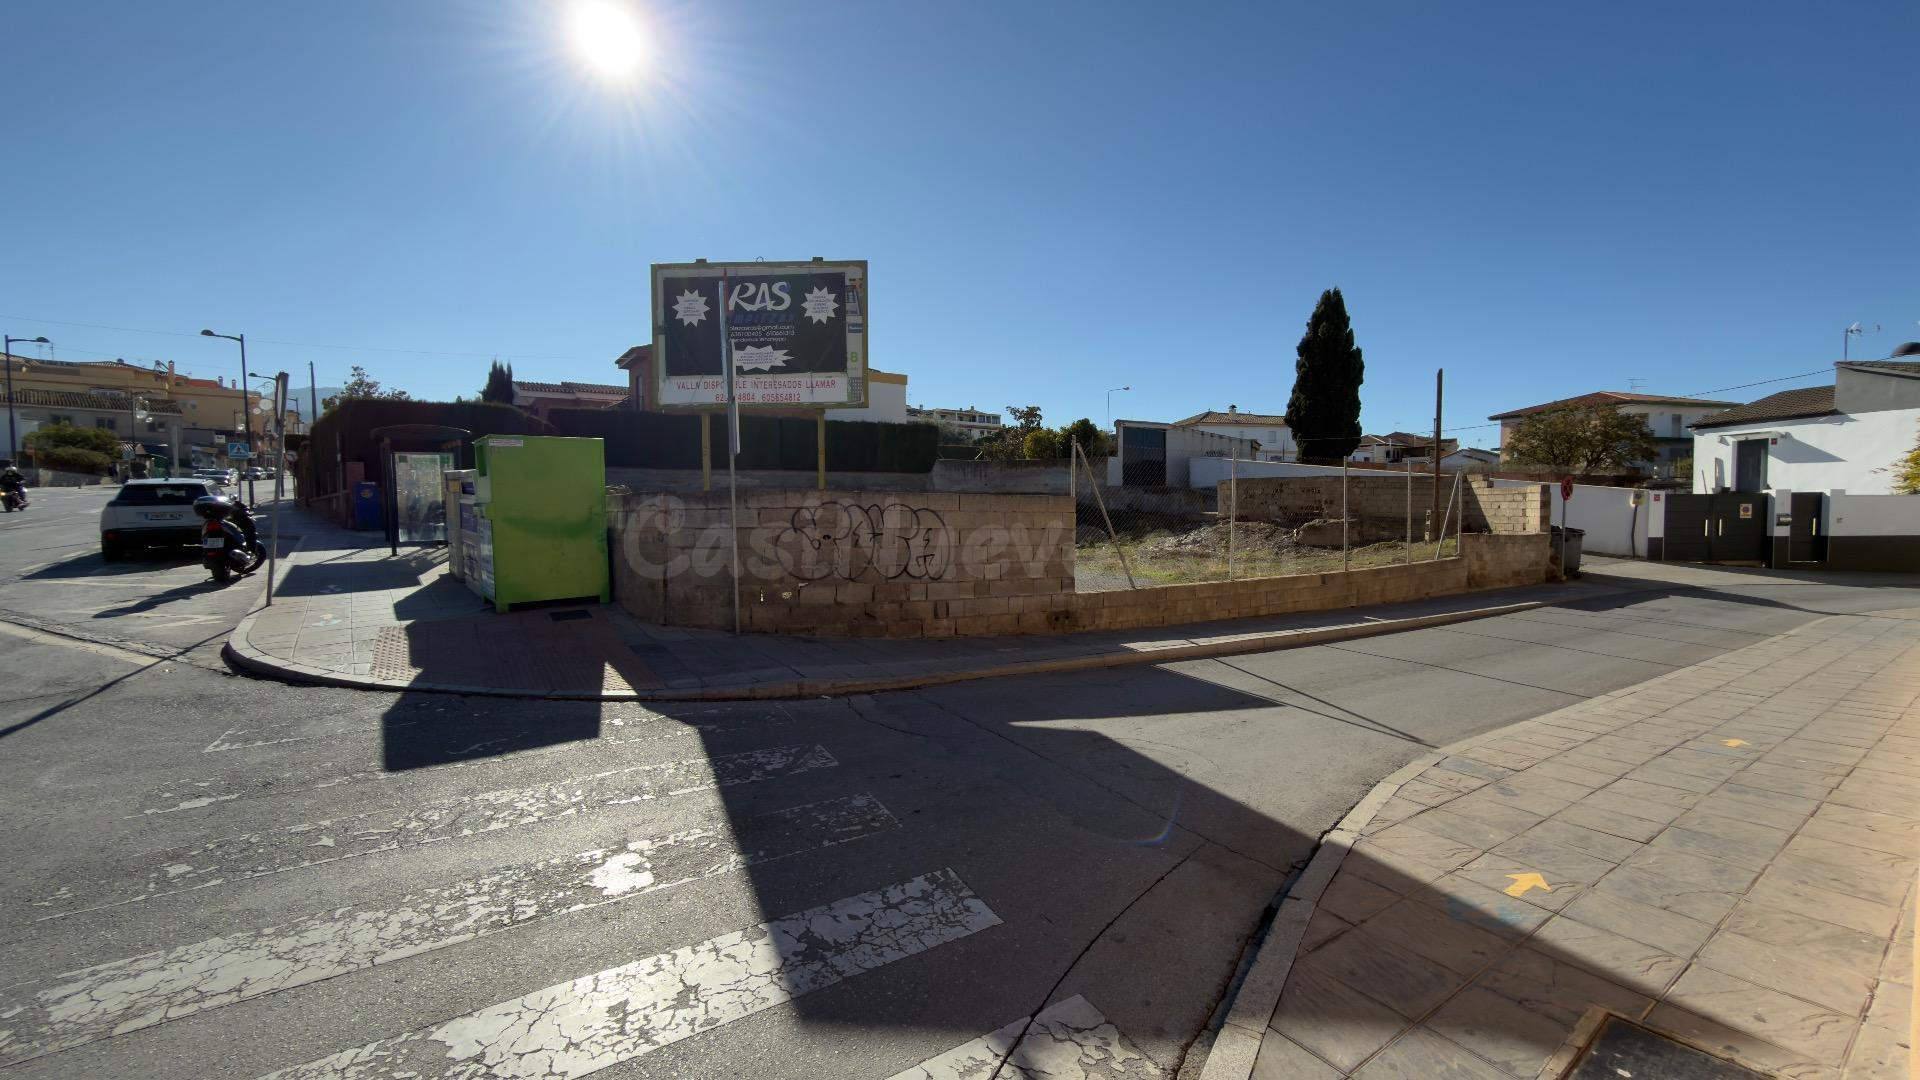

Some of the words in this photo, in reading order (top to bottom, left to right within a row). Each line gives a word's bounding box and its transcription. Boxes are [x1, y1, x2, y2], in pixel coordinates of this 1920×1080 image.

[728, 281, 791, 311] RAS
[751, 380, 802, 390] INTERESADOS
[806, 379, 836, 389] LLAMAR
